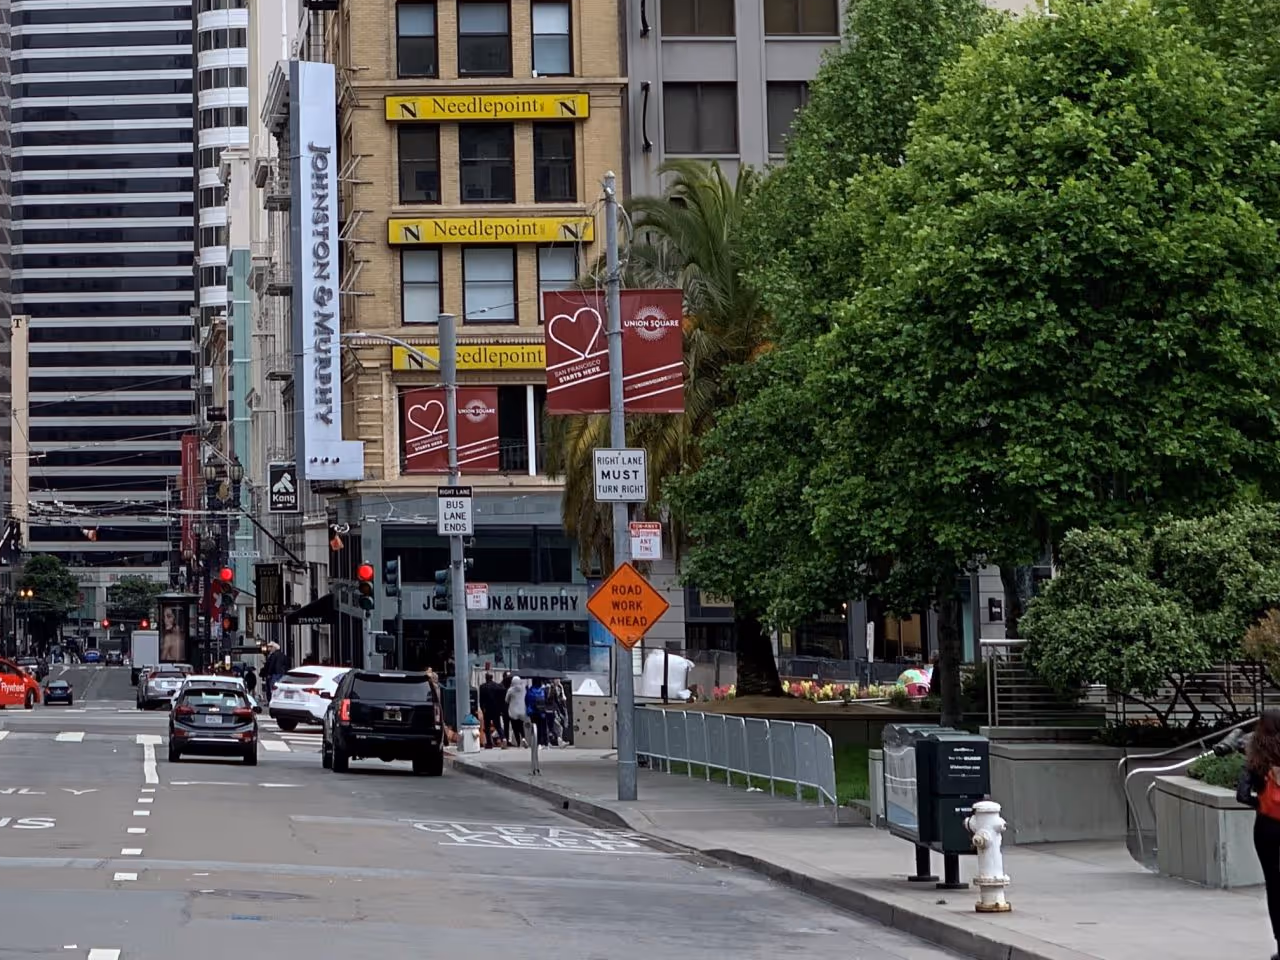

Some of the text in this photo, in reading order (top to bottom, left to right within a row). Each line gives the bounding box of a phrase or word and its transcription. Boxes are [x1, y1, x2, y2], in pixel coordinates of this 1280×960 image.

[432, 96, 538, 117] Needlepoint
[433, 219, 538, 240] Needlepoint
[308, 141, 335, 426] JOHNSTON & MURPHY
[650, 319, 679, 327] SQUARE
[455, 346, 544, 367] eedlepoint
[554, 359, 601, 378] SAN FRANCISCO
[559, 366, 601, 384] STARTS HERE
[597, 456, 642, 465] RIGHT LANE
[601, 470, 640, 480] MUST
[598, 485, 644, 494] TURN RIGHT
[446, 501, 464, 509] BUS
[444, 512, 467, 520] LANE
[444, 523, 467, 531] ENDS
[611, 585, 642, 595] ROAD
[503, 595, 515, 611] &
[517, 595, 579, 611] MURPHY
[611, 601, 643, 610] WORK
[260, 605, 278, 614] ART
[610, 616, 648, 627] AHEAD
[1, 682, 25, 694] Flywheel
[413, 822, 650, 842] CLEAR
[445, 832, 641, 851] KEEP
